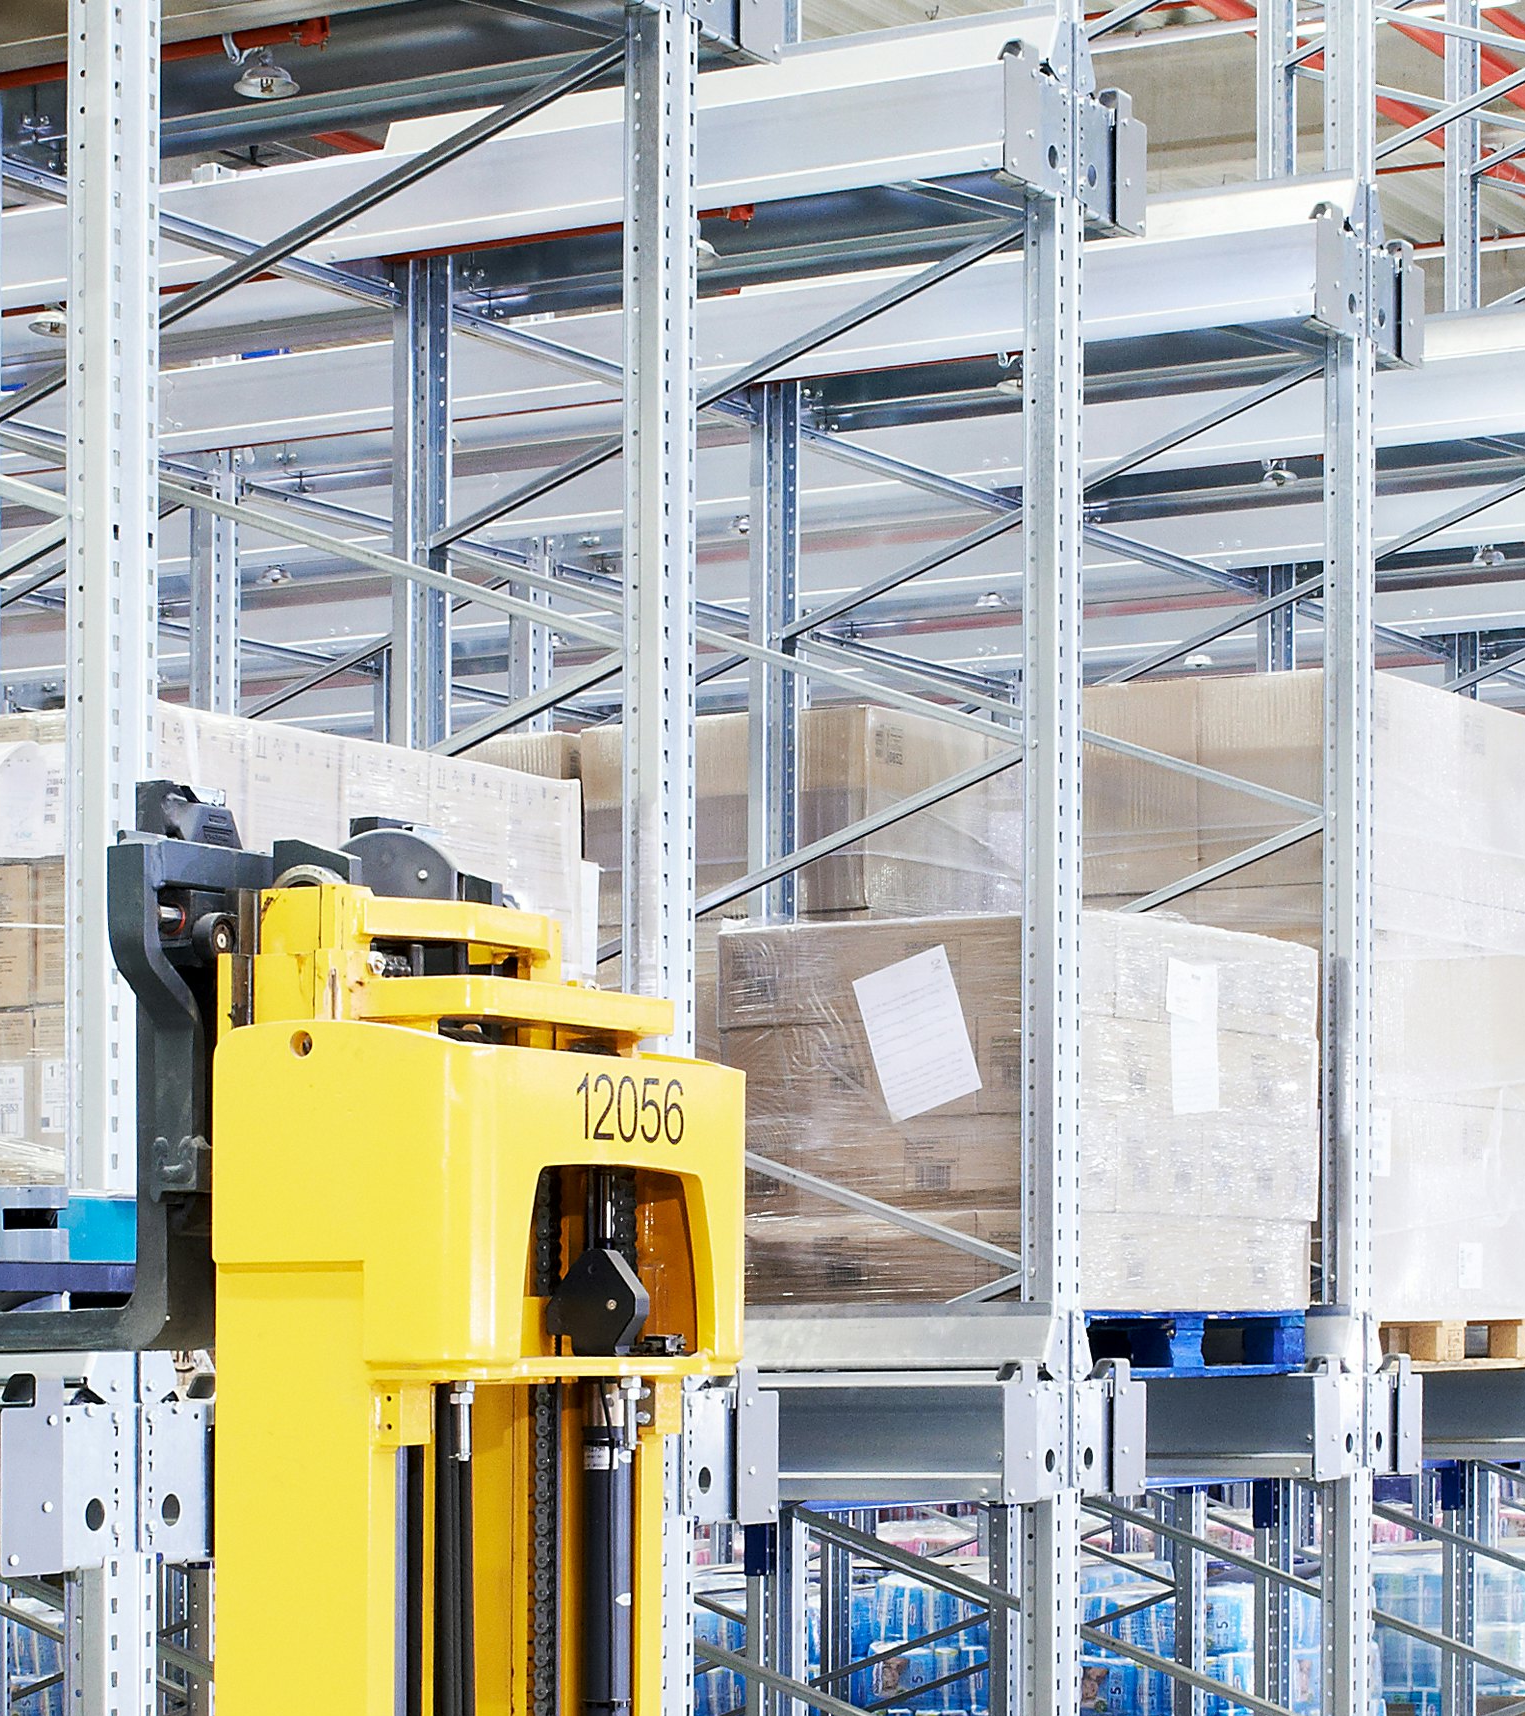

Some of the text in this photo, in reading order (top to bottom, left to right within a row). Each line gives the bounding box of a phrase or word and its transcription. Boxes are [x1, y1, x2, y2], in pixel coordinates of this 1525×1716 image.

[49, 1065, 55, 1077] 1
[0, 1103, 19, 1113] 2553
[575, 1071, 686, 1146] 12056
[1109, 1686, 1122, 1697] 5
